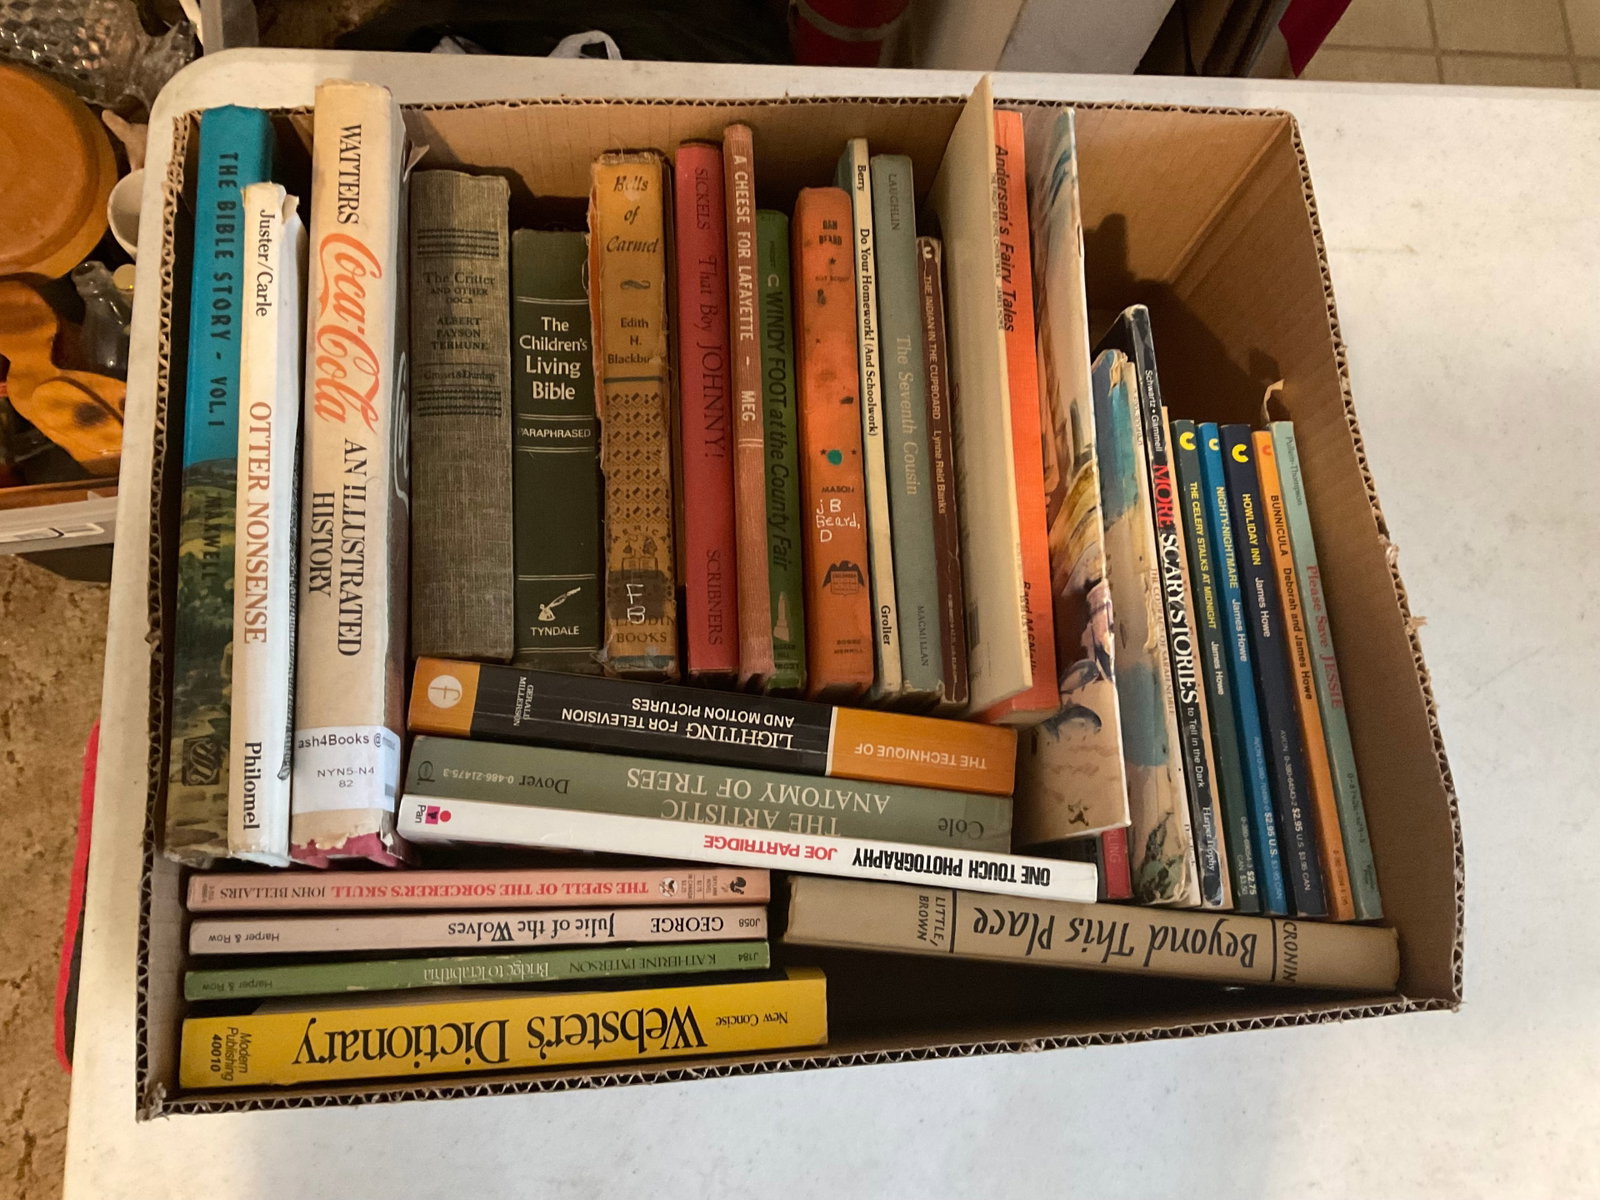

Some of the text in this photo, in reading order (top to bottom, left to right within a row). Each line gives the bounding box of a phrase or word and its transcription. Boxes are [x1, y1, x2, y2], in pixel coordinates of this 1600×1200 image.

[218, 152, 239, 189] THE
[336, 124, 362, 225] WATTERS
[856, 164, 867, 192] Berry
[994, 144, 1013, 236] Andersen's
[623, 206, 640, 224] of
[694, 167, 711, 231] SICKELS
[888, 173, 901, 231] LAUGHLIN
[214, 200, 237, 260] BIBLE
[606, 235, 660, 253] Carmel
[256, 209, 276, 317] Juster/Carle
[423, 272, 496, 286] The Critter
[698, 257, 719, 295] That
[1000, 242, 1016, 284] Fairy
[734, 170, 756, 422] CHEESE FOR LAFAYETTE MEG
[860, 228, 875, 341] Do Your Homework!
[210, 272, 233, 340] STORY
[437, 317, 482, 326] ALBERT
[540, 316, 570, 332] The
[620, 317, 649, 329] Edith
[694, 302, 719, 332] Boy
[1002, 290, 1018, 333] Tales
[431, 342, 489, 350] TERHUNE
[436, 329, 481, 338] PAYSON
[519, 334, 588, 352] Children's
[525, 354, 582, 379] Living
[532, 381, 576, 400] Bible
[929, 364, 941, 420] CUPBOARD
[1145, 369, 1157, 408] Schwartz
[518, 427, 591, 439] PARAPHRASED
[766, 291, 793, 572] WINDY FOOT at the County Fair
[896, 335, 921, 496] The Seventh Cousin
[821, 485, 855, 494] MASON
[244, 401, 272, 644] OTTER NONSENSE
[1216, 486, 1239, 589] NIGHTY-NIGHTMARE
[1242, 493, 1262, 567] HOWLIDAY INN
[1270, 494, 1289, 557] BUNNICULA
[308, 491, 335, 598] HISTORY
[337, 438, 368, 657] AN ILLUSTRATED
[1191, 501, 1217, 630] CELERY STALKS MIDNIGHT
[627, 605, 646, 625] B
[705, 549, 723, 646] SCRIBNERS
[1255, 577, 1271, 638] James Howe
[530, 625, 580, 637] TYNDALE
[616, 631, 668, 643] BOOKS
[880, 604, 891, 646] Grolier
[917, 605, 929, 667] MACMILLAN
[1153, 464, 1205, 788] MORE SCARY STORIES Dark
[1232, 598, 1248, 662] James Howe
[1282, 567, 1313, 700] Deborah James Howe
[1306, 565, 1344, 709] Please Save JESSIE
[1211, 641, 1221, 669] James
[513, 675, 528, 727] MILLERSON
[523, 684, 535, 721] GERALD
[632, 697, 795, 729] AND MOTION PICTURES
[562, 708, 795, 750] LIGHTING FOR TELEVISION
[854, 743, 988, 770] THE TECHNIQUE OF
[243, 741, 262, 831] Philomel
[338, 779, 354, 788] 82
[518, 774, 571, 794] Dover
[626, 767, 891, 815] ANATOMY OF TREES
[414, 804, 427, 823] Pan
[660, 799, 841, 837] THE ARTISTIC
[937, 816, 985, 840] Cole
[703, 834, 838, 861] JOE PARTRIDGE
[852, 847, 1052, 887] ONE TOUCH PHOTOGRAPHY
[219, 885, 288, 900] BELLAIRS
[294, 885, 326, 899] JOHN
[331, 881, 650, 899] THE SPELL OF THE SORCERER'S SKULL
[448, 911, 616, 943] Julie of the Wolves
[650, 915, 724, 934] GEORGE
[916, 894, 930, 941] BROWN
[930, 896, 946, 947] LITTLE,
[207, 932, 280, 944] Harper Row
[973, 906, 1258, 969] Beyond This Place
[1282, 920, 1298, 984] CRONIN
[487, 964, 503, 980] to
[506, 961, 549, 983] Bridge
[569, 952, 717, 974] KATHERINE PATERSON
[202, 980, 273, 992] Harper Row
[291, 1004, 709, 1069] Webster's Dictionary
[715, 1011, 788, 1027] New Concise
[210, 1033, 223, 1073] 40010
[221, 1025, 239, 1082] Publishing
[238, 1032, 253, 1075] Modern
